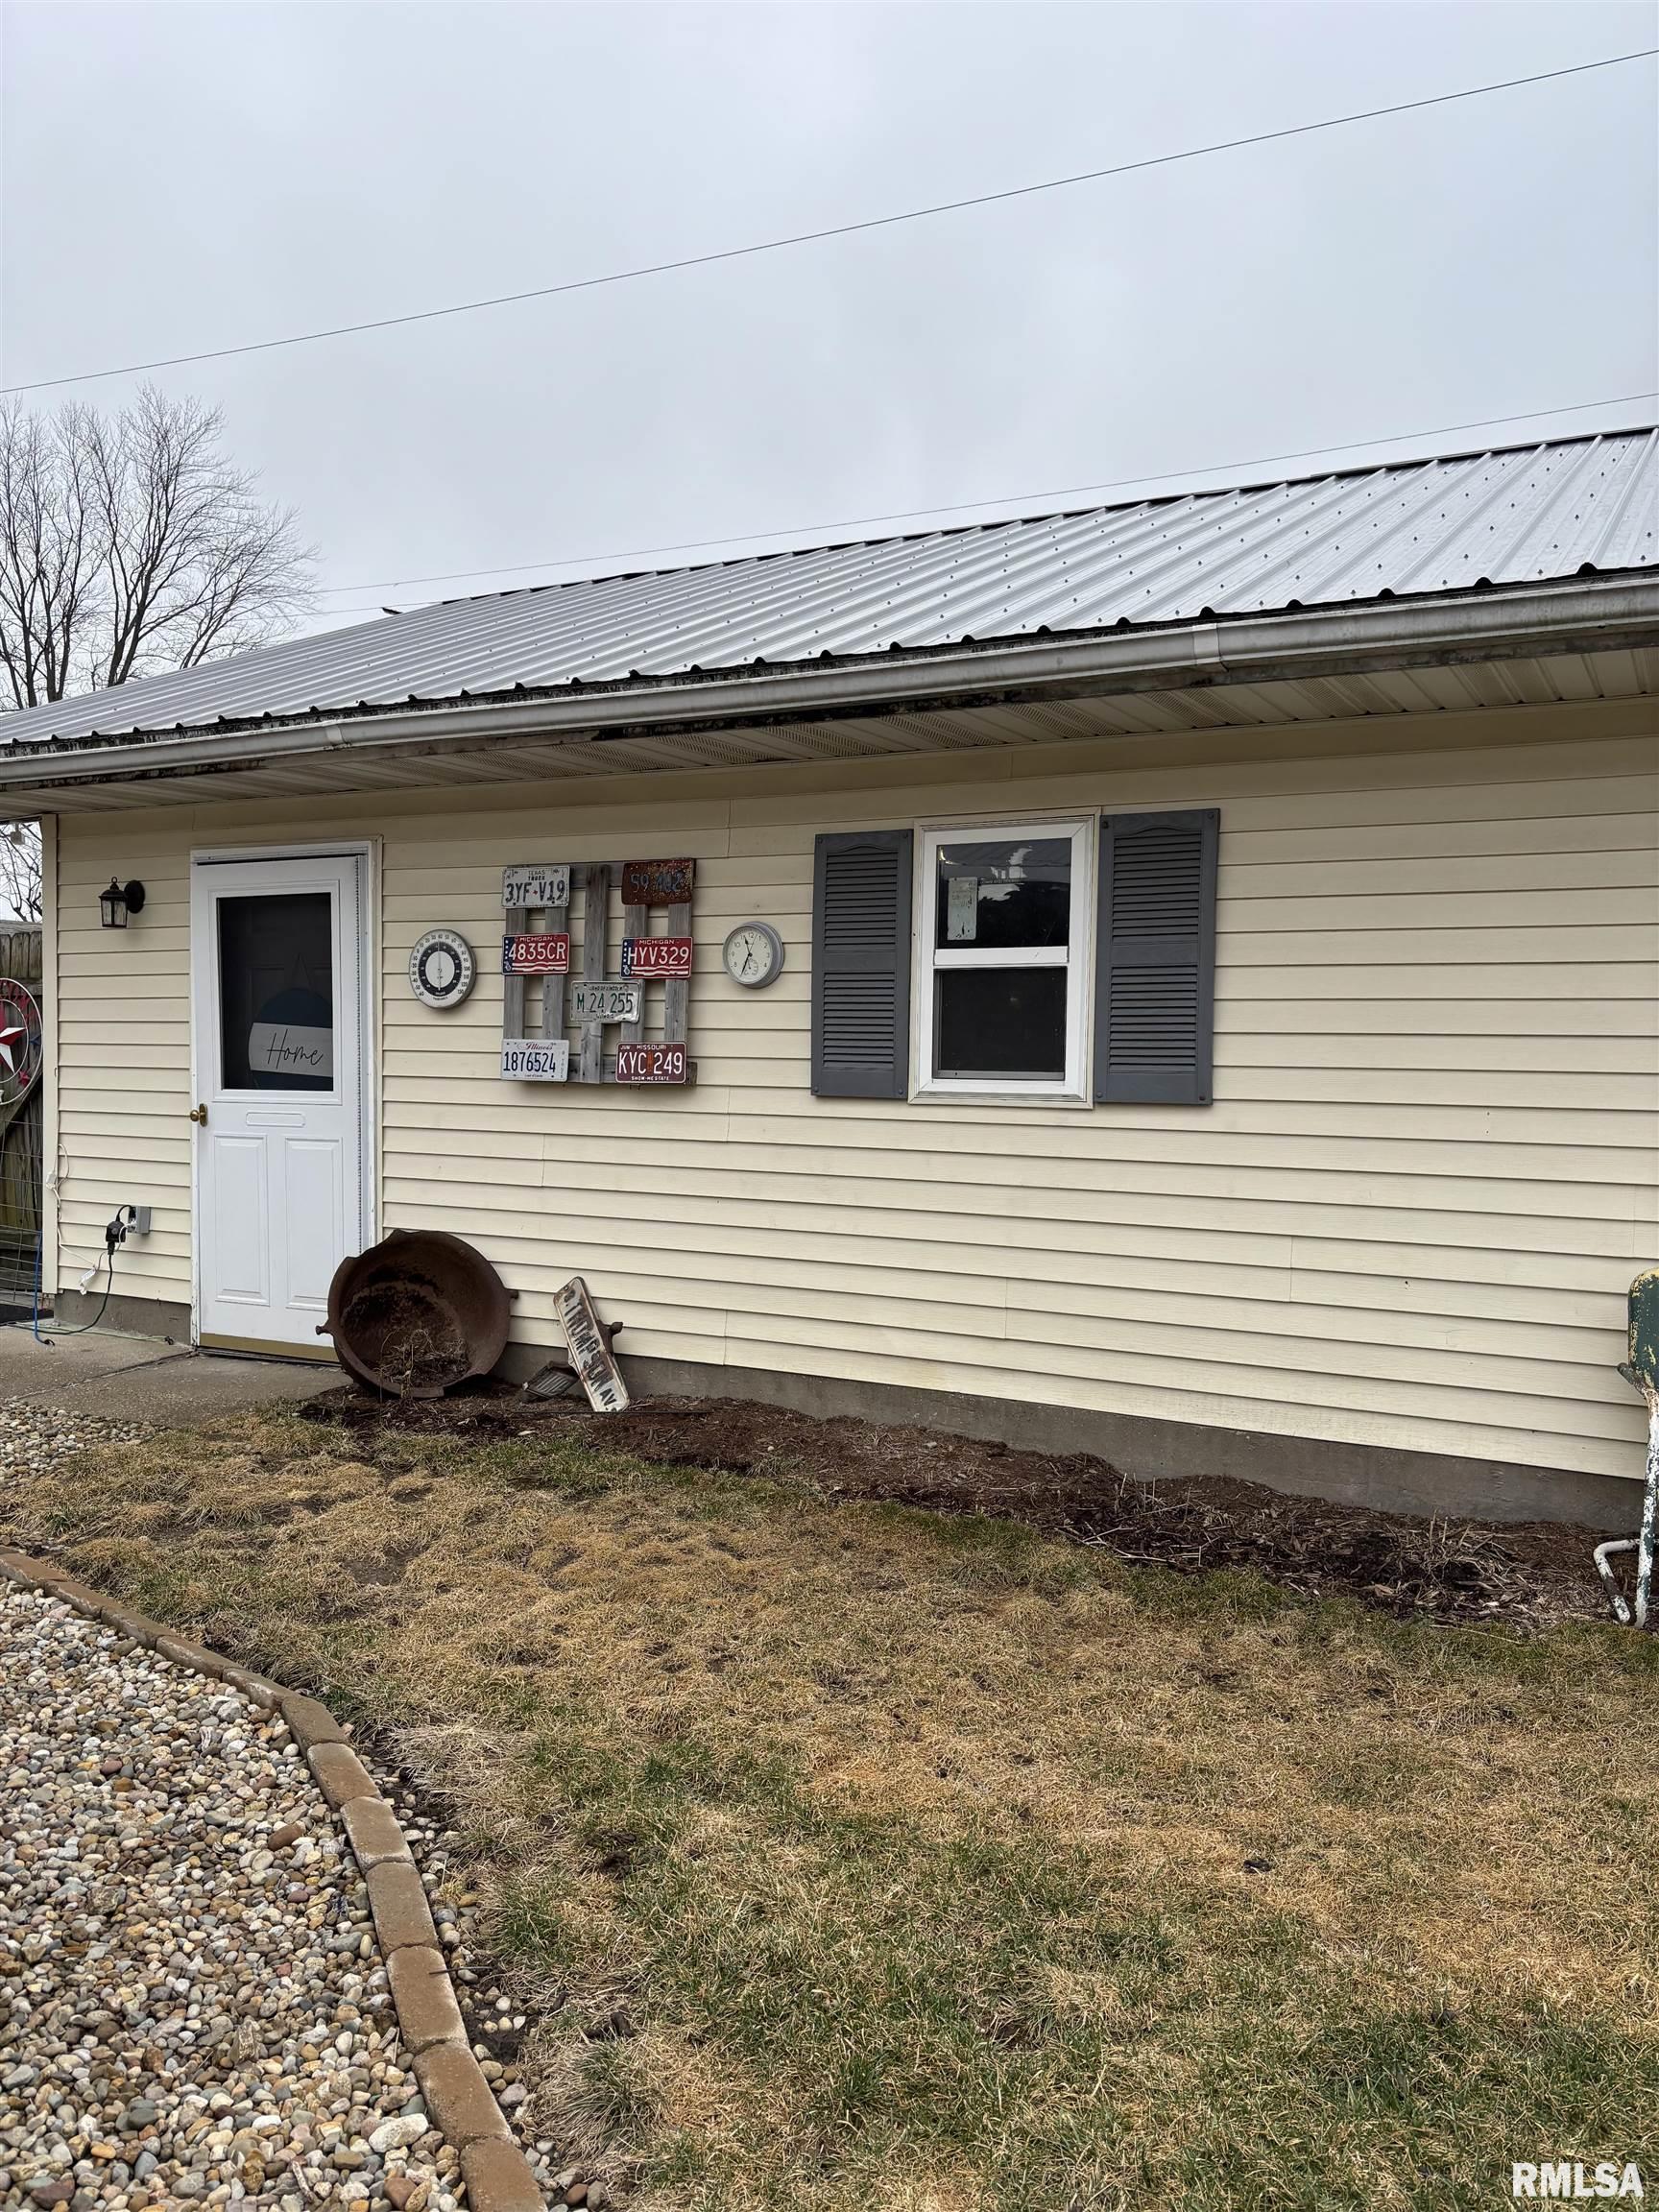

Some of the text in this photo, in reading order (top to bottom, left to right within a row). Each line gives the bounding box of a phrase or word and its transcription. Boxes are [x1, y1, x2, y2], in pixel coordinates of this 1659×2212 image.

[509, 943, 565, 960] 4835CR
[627, 947, 689, 965] HYV329
[610, 993, 634, 1013] 255
[266, 1028, 324, 1070] Home
[503, 1051, 556, 1072] 1876524
[618, 1052, 683, 1074] KYC 249
[565, 1301, 613, 1392] THOMPSON
